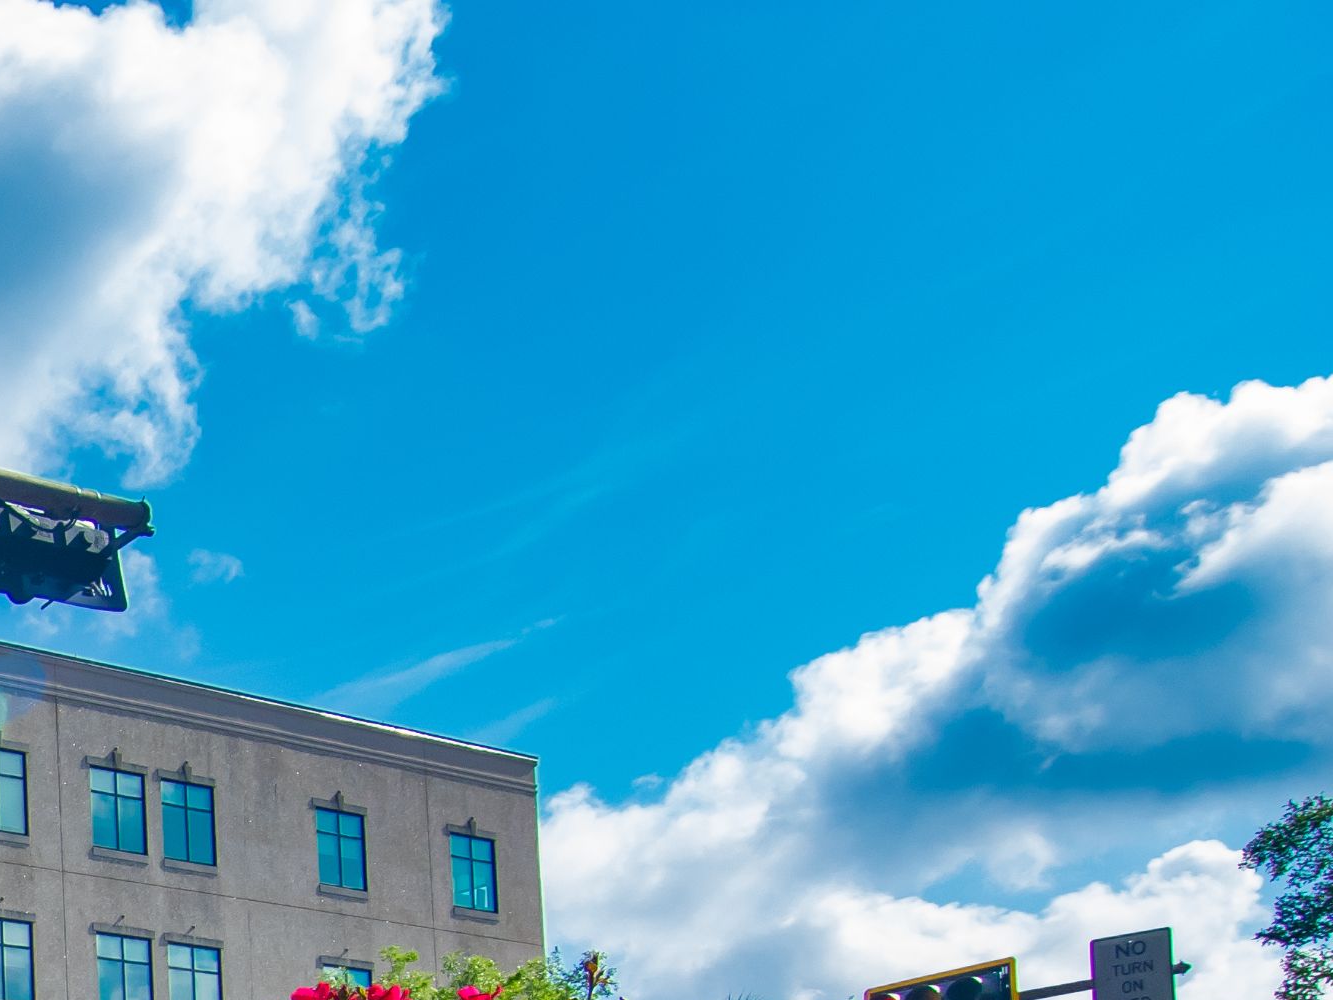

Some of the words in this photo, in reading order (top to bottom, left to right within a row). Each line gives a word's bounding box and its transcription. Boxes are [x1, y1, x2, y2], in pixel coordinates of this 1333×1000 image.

[1115, 940, 1146, 959] NO
[1112, 960, 1153, 976] TURN
[1122, 979, 1144, 993] ON
